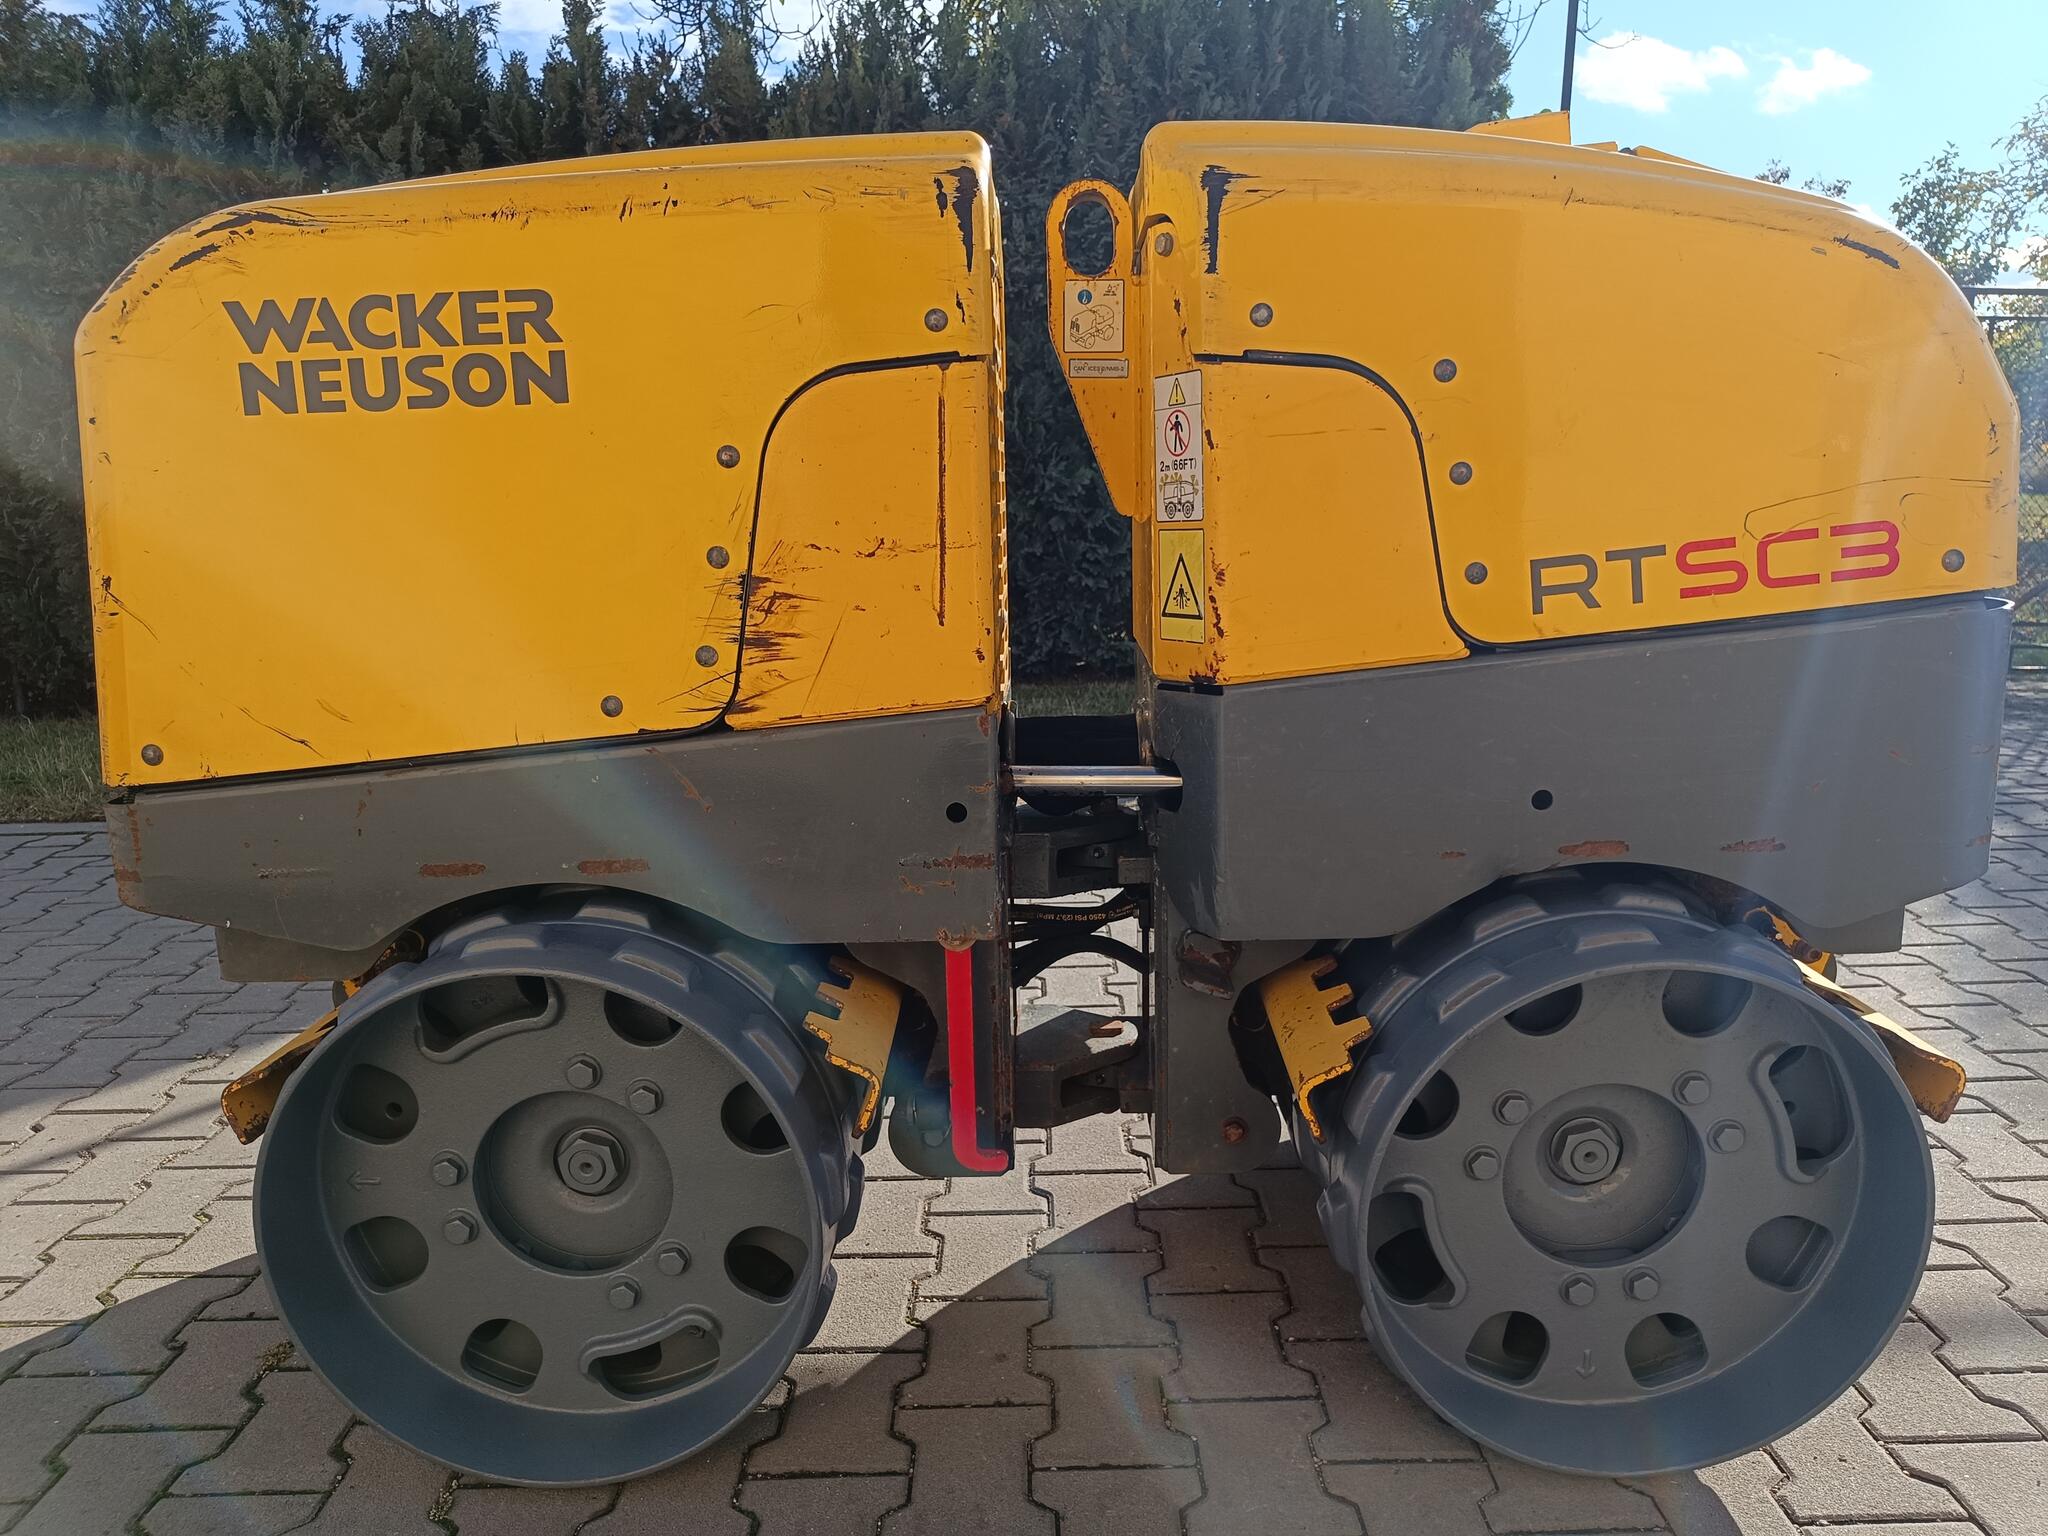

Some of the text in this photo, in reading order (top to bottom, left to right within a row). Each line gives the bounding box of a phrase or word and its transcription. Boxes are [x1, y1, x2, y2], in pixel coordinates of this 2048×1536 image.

[221, 288, 564, 355] WACKER
[238, 350, 570, 416] NEUSON
[1160, 460, 1171, 472] 2m
[1529, 519, 1901, 616] RTSC3
[1074, 913, 1088, 921] PSI
[1088, 912, 1106, 920] 4250
